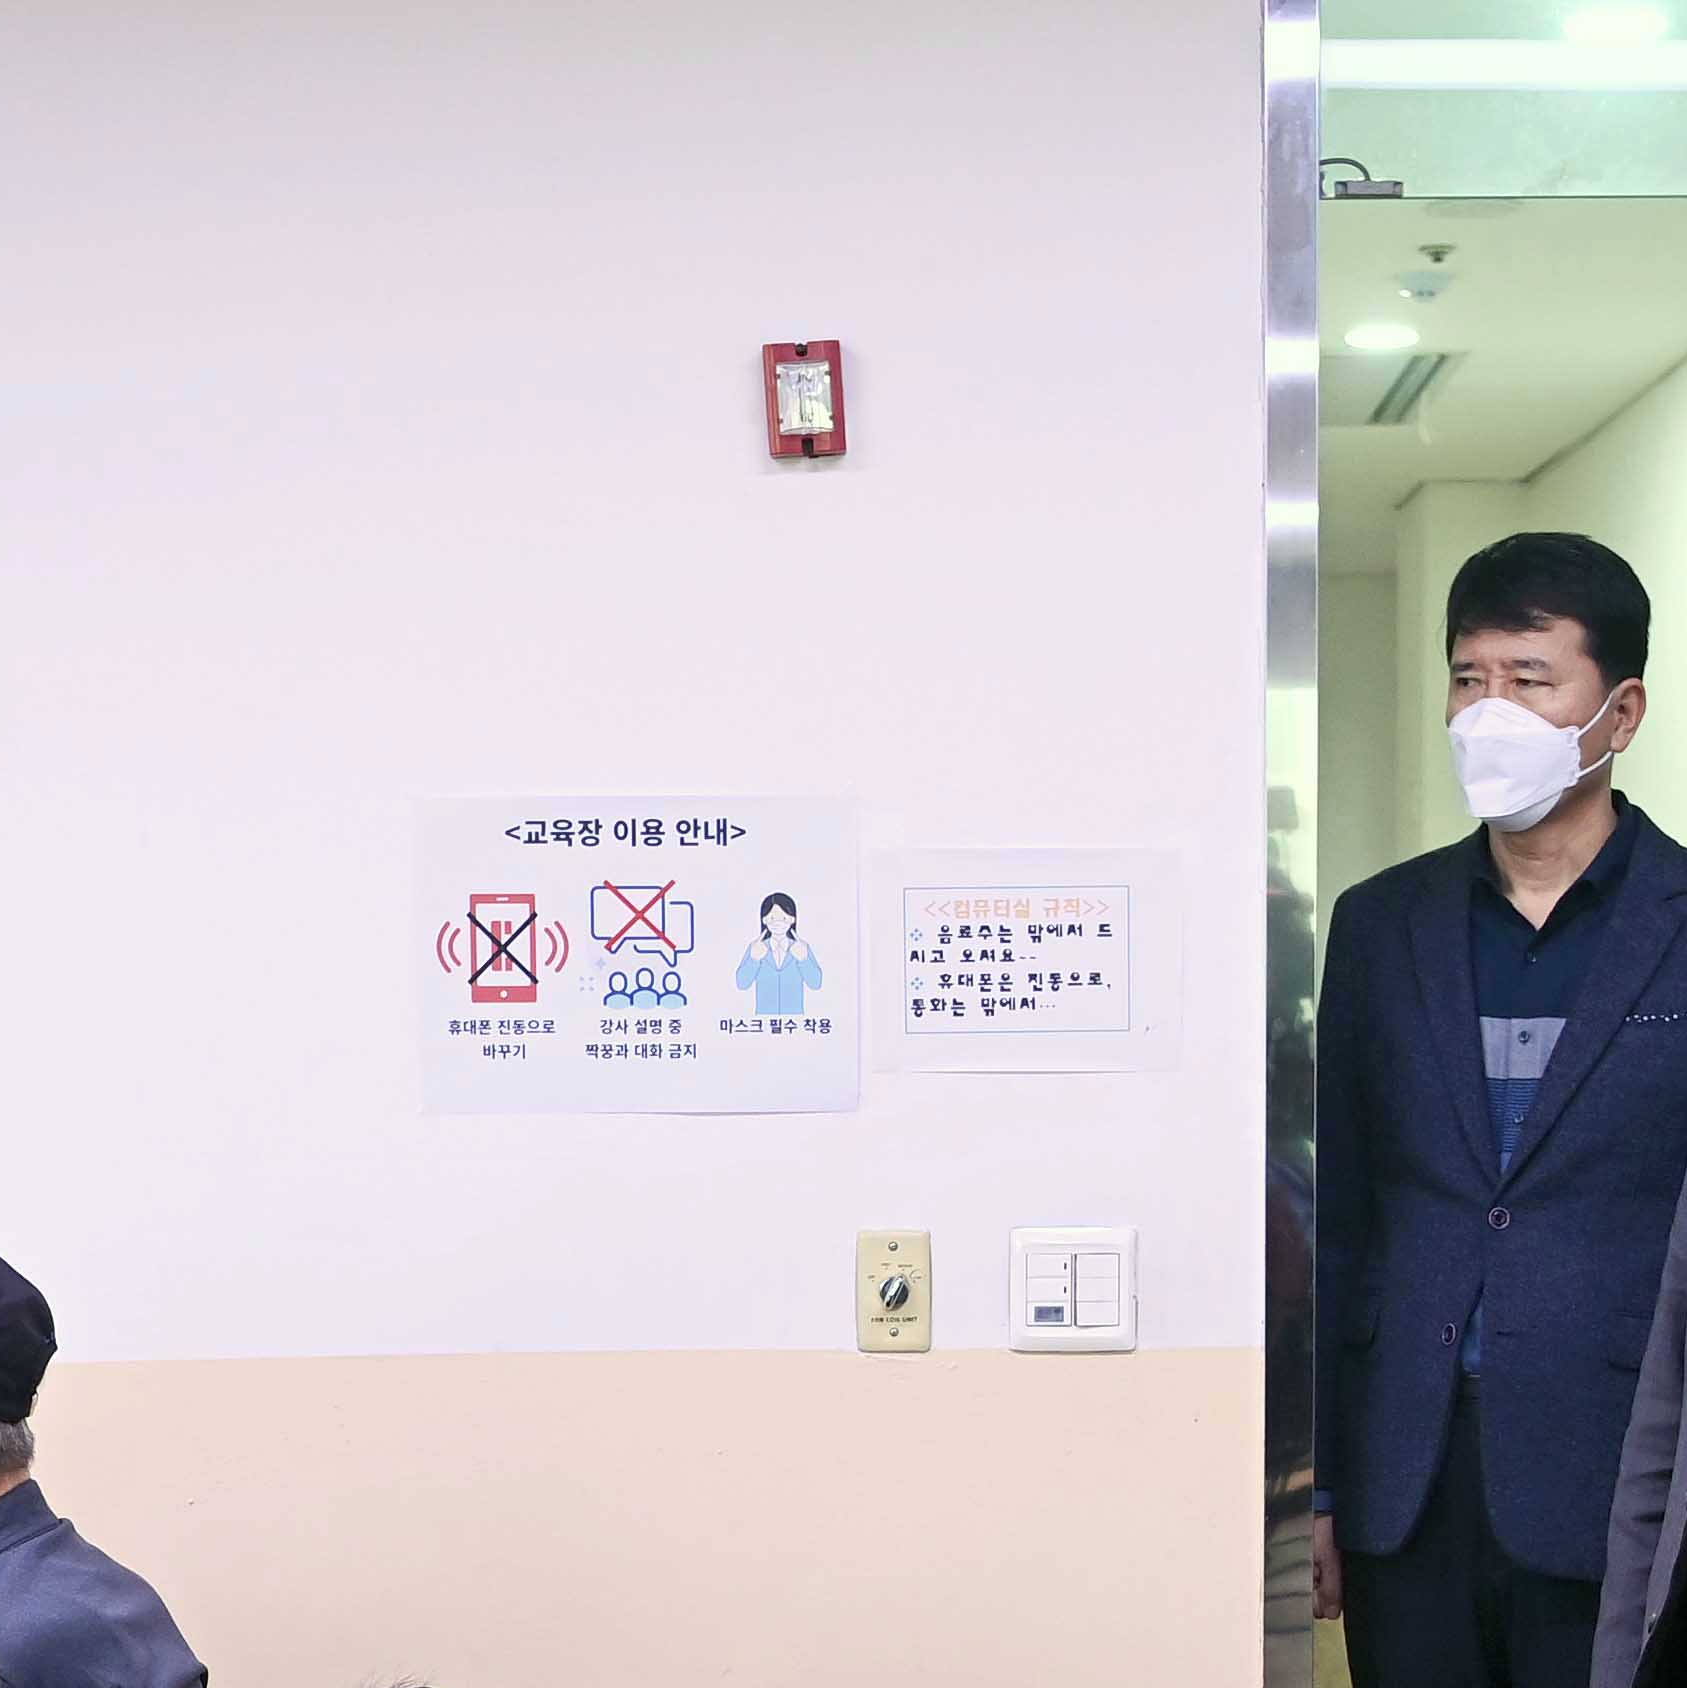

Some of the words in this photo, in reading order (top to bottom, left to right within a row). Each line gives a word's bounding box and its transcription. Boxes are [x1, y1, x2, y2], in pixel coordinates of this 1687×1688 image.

[504, 818, 603, 848] <교육장
[613, 818, 666, 848] 이용
[675, 817, 747, 847] 안내>
[937, 923, 1013, 945] 음료수는
[1096, 922, 1113, 938] 드
[909, 948, 946, 964] 시고
[937, 971, 1014, 993] 휴대폰은
[910, 997, 966, 1018] 통화는
[448, 1018, 493, 1036] 휴대폰
[497, 1018, 557, 1036] 진동으로
[599, 1018, 629, 1036] 강사
[634, 1018, 663, 1036] 설명
[668, 1018, 683, 1036] 중
[719, 1018, 764, 1035] 마스크
[769, 1018, 798, 1035] 필수
[803, 1018, 832, 1035] 착용
[483, 1043, 526, 1060] 바꾸기
[585, 1043, 628, 1060] 짝꿍과
[634, 1043, 663, 1060] 대화
[667, 1043, 697, 1060] 금지
